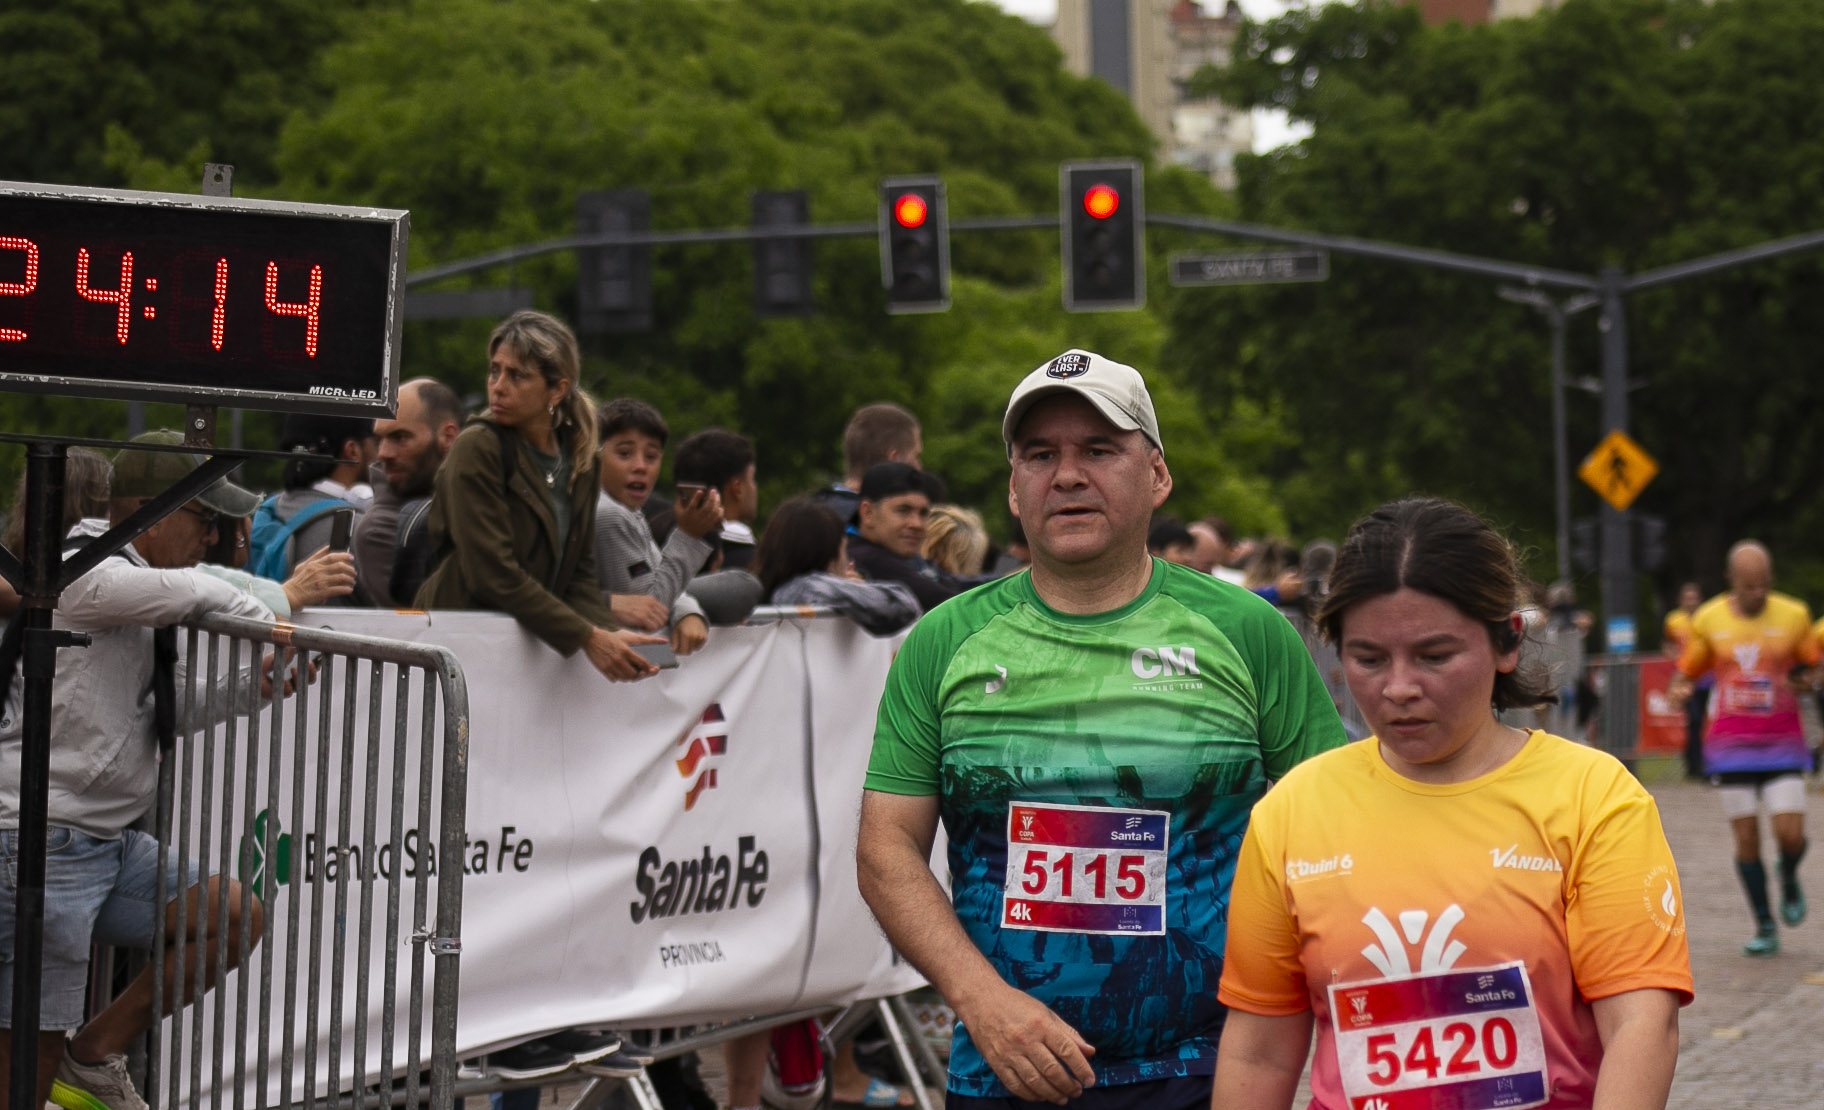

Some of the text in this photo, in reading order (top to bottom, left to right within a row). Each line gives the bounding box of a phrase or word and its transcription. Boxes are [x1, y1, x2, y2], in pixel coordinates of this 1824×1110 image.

[1055, 363, 1079, 373] LAST
[1132, 647, 1201, 679] CM
[1179, 682, 1204, 690] TEAM
[1111, 831, 1156, 842] Santa Fe
[497, 826, 534, 874] Fe
[630, 835, 769, 924] Santa Fe
[1021, 850, 1146, 900] 5115
[1010, 902, 1032, 921] 4k
[1465, 989, 1516, 1004] Santa Fe
[1366, 1016, 1518, 1086] 5420
